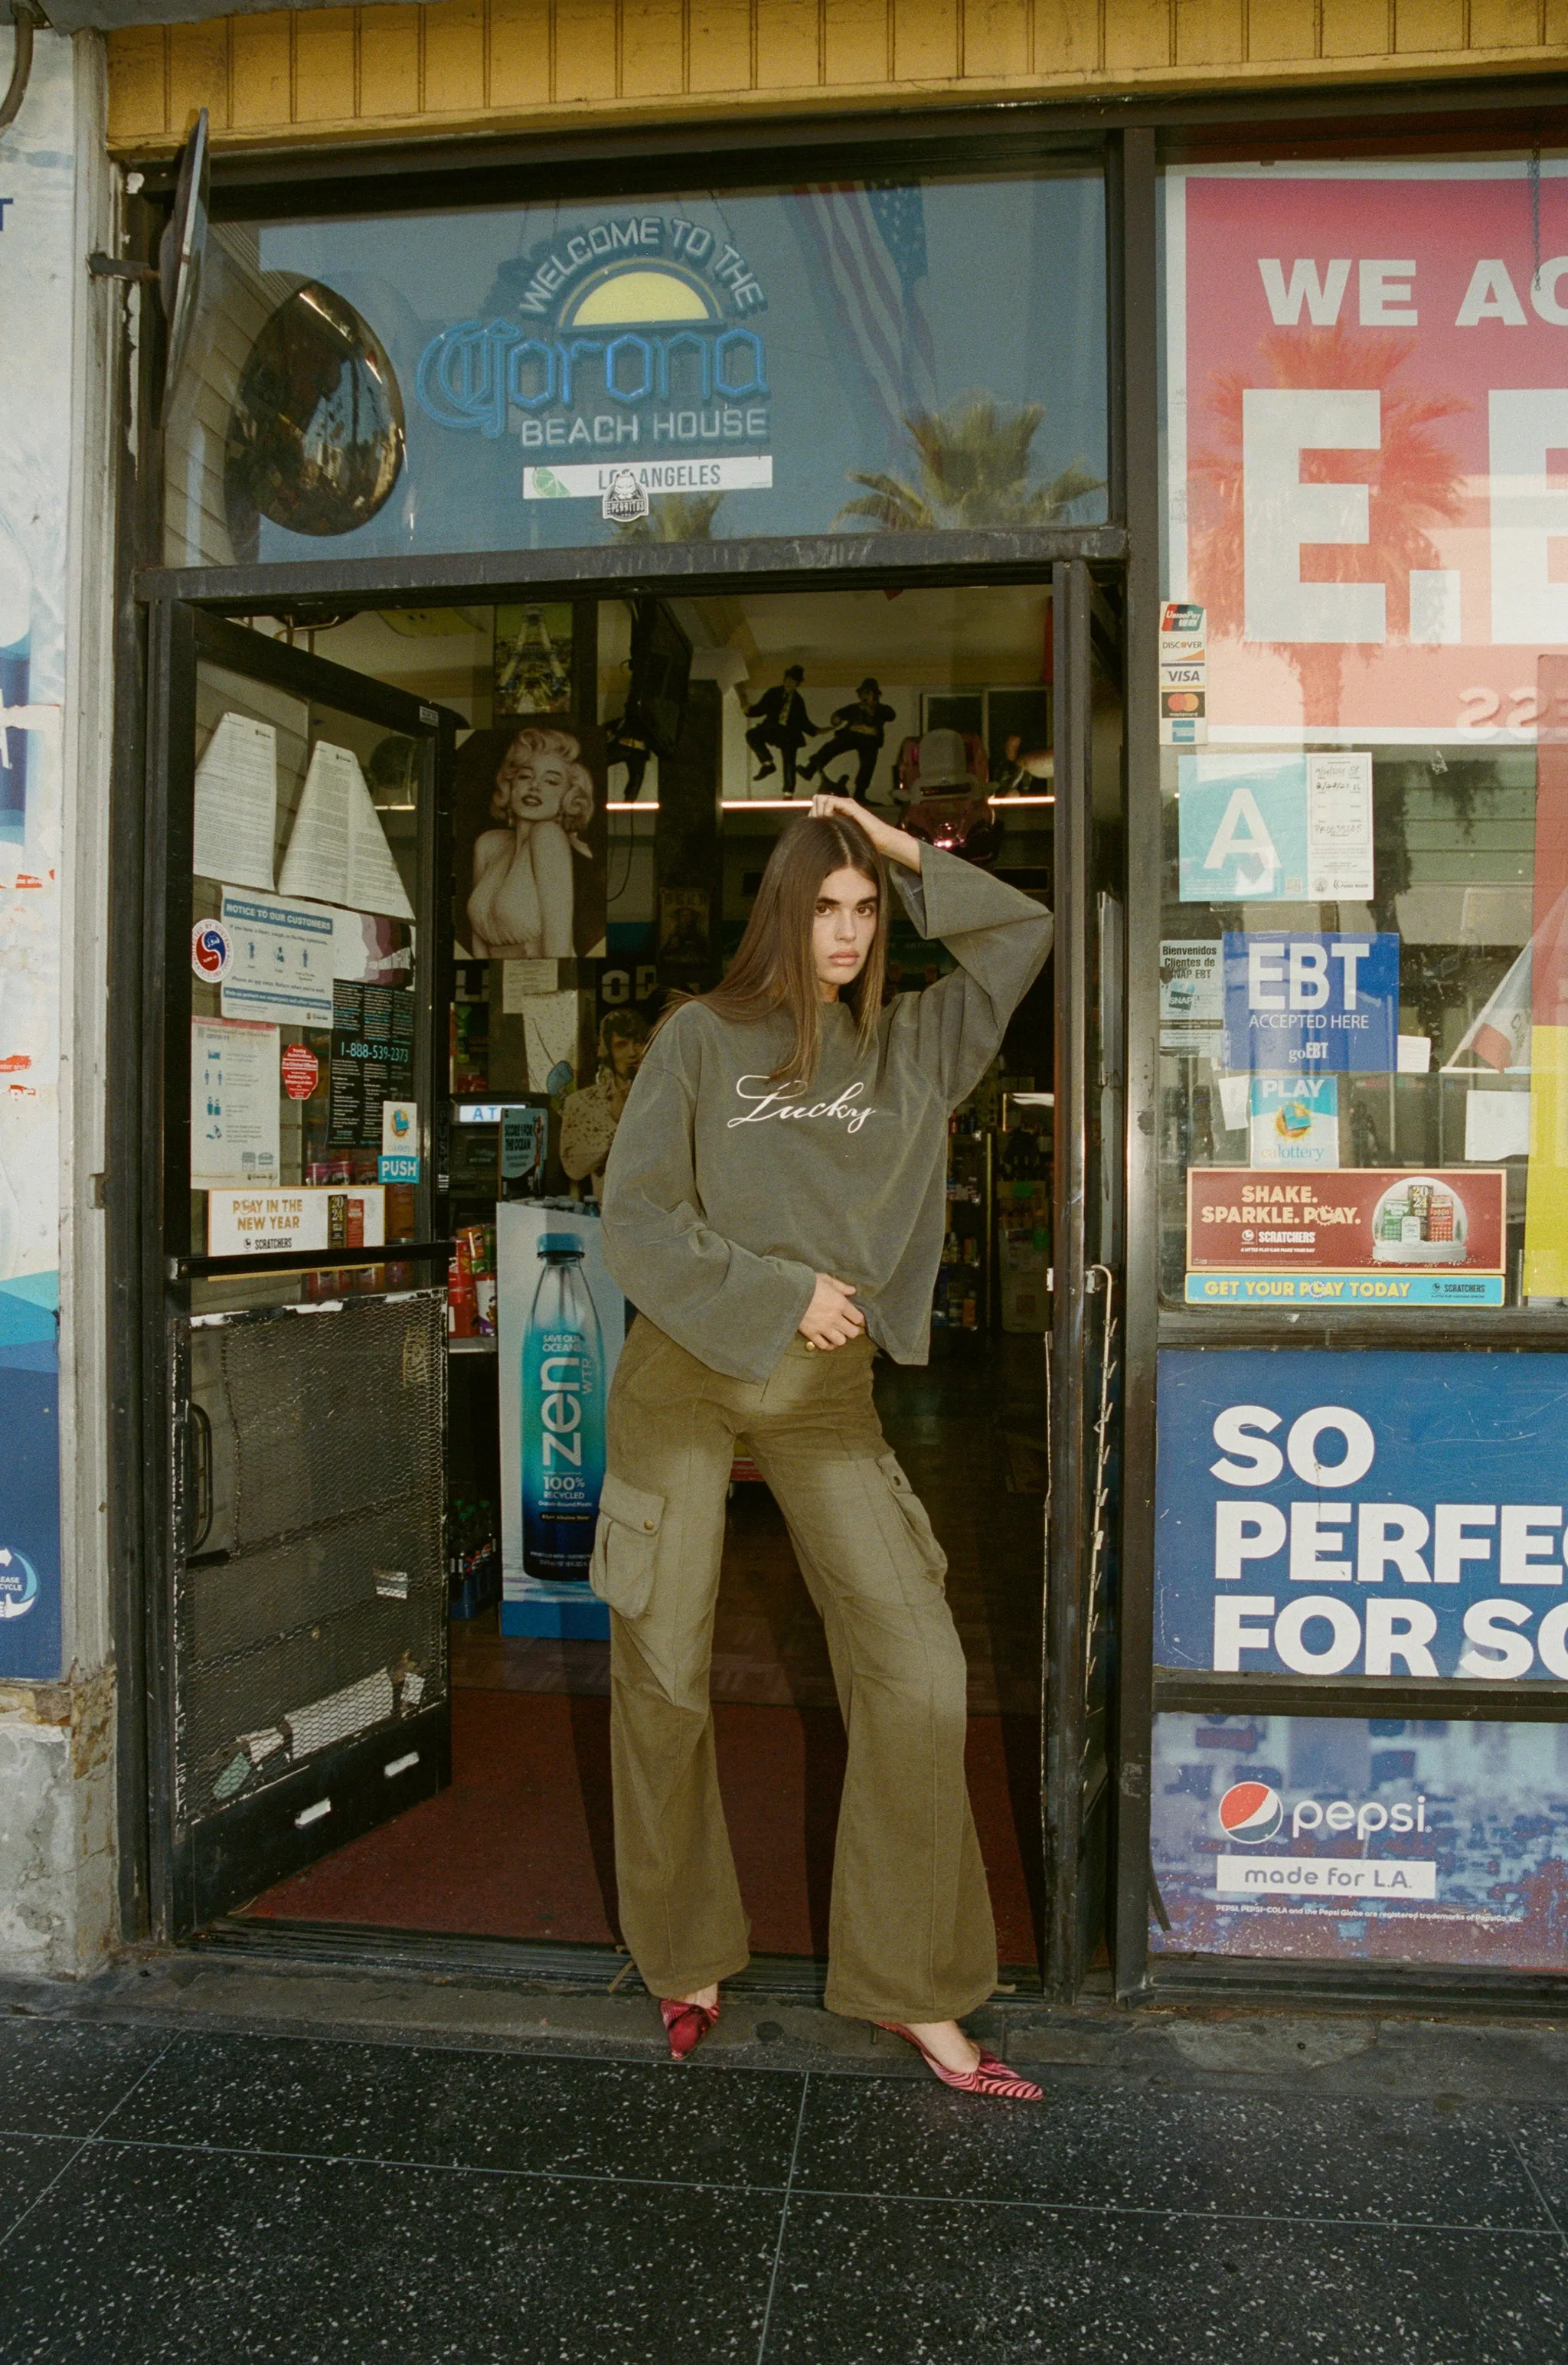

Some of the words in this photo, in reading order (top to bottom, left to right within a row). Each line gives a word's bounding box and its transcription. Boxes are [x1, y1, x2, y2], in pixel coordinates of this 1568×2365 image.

[519, 217, 661, 316] WELCOME
[671, 218, 710, 256] TO
[712, 245, 764, 310] THE
[1258, 259, 1417, 325] WE
[416, 316, 770, 438] Corona
[522, 415, 639, 448] BEACH
[654, 409, 766, 441] HOUSE
[639, 464, 721, 488] ANGELES
[1167, 670, 1200, 681] VISA
[1203, 788, 1282, 869] A
[227, 903, 256, 916] NOTICE
[257, 910, 268, 919] TO
[269, 912, 286, 923] OUR
[287, 916, 332, 930] CUSTOMERS
[1162, 946, 1217, 955] Bienvenidos
[1165, 958, 1200, 967] Clientes
[1204, 958, 1215, 967] de
[1195, 969, 1211, 978] EBT
[1249, 943, 1370, 1010] EBT
[1249, 1014, 1327, 1028] ACCEPTED
[1331, 1015, 1369, 1028] HERE
[341, 1041, 409, 1063] 1-888-539-2373
[1289, 1042, 1328, 1063] goEBT
[1262, 1080, 1325, 1098] PLAY
[727, 1075, 876, 1133] Lucky
[1262, 1145, 1324, 1161] calottery
[381, 1160, 416, 1177] PUSH
[1241, 1186, 1318, 1203] SHAKE.
[1413, 1186, 1429, 1197] 20
[267, 1200, 279, 1213] IN
[282, 1199, 302, 1212] THE
[332, 1195, 344, 1208] 20
[1413, 1197, 1428, 1207] 24
[332, 1208, 344, 1221] 24
[1201, 1207, 1299, 1223] SPARKLE.
[237, 1217, 266, 1231] NEW
[270, 1216, 299, 1230] YEAR
[255, 1238, 292, 1249] SCRATCHERS
[1259, 1231, 1315, 1243] SCRATCHERS
[1204, 1281, 1240, 1296] GET
[1245, 1281, 1295, 1296] YOUR
[1349, 1282, 1412, 1298] TODAY
[1444, 1284, 1485, 1293] SCRATCHERS
[542, 1334, 562, 1343] SAVE
[540, 1357, 581, 1467] zen
[1210, 1404, 1376, 1488] SO
[543, 1476, 585, 1491] 100%
[1215, 1501, 1568, 1585] PERFE
[1214, 1595, 1439, 1677] FOR
[1292, 1795, 1426, 1840] pepsi
[1245, 1867, 1318, 1885] made
[1328, 1867, 1365, 1886] for
[1374, 1869, 1412, 1888] L.A.
[1241, 1905, 1287, 1914] PEPSI-COLA
[1379, 1912, 1418, 1920] registered
[1419, 1913, 1465, 1921] trademarks
